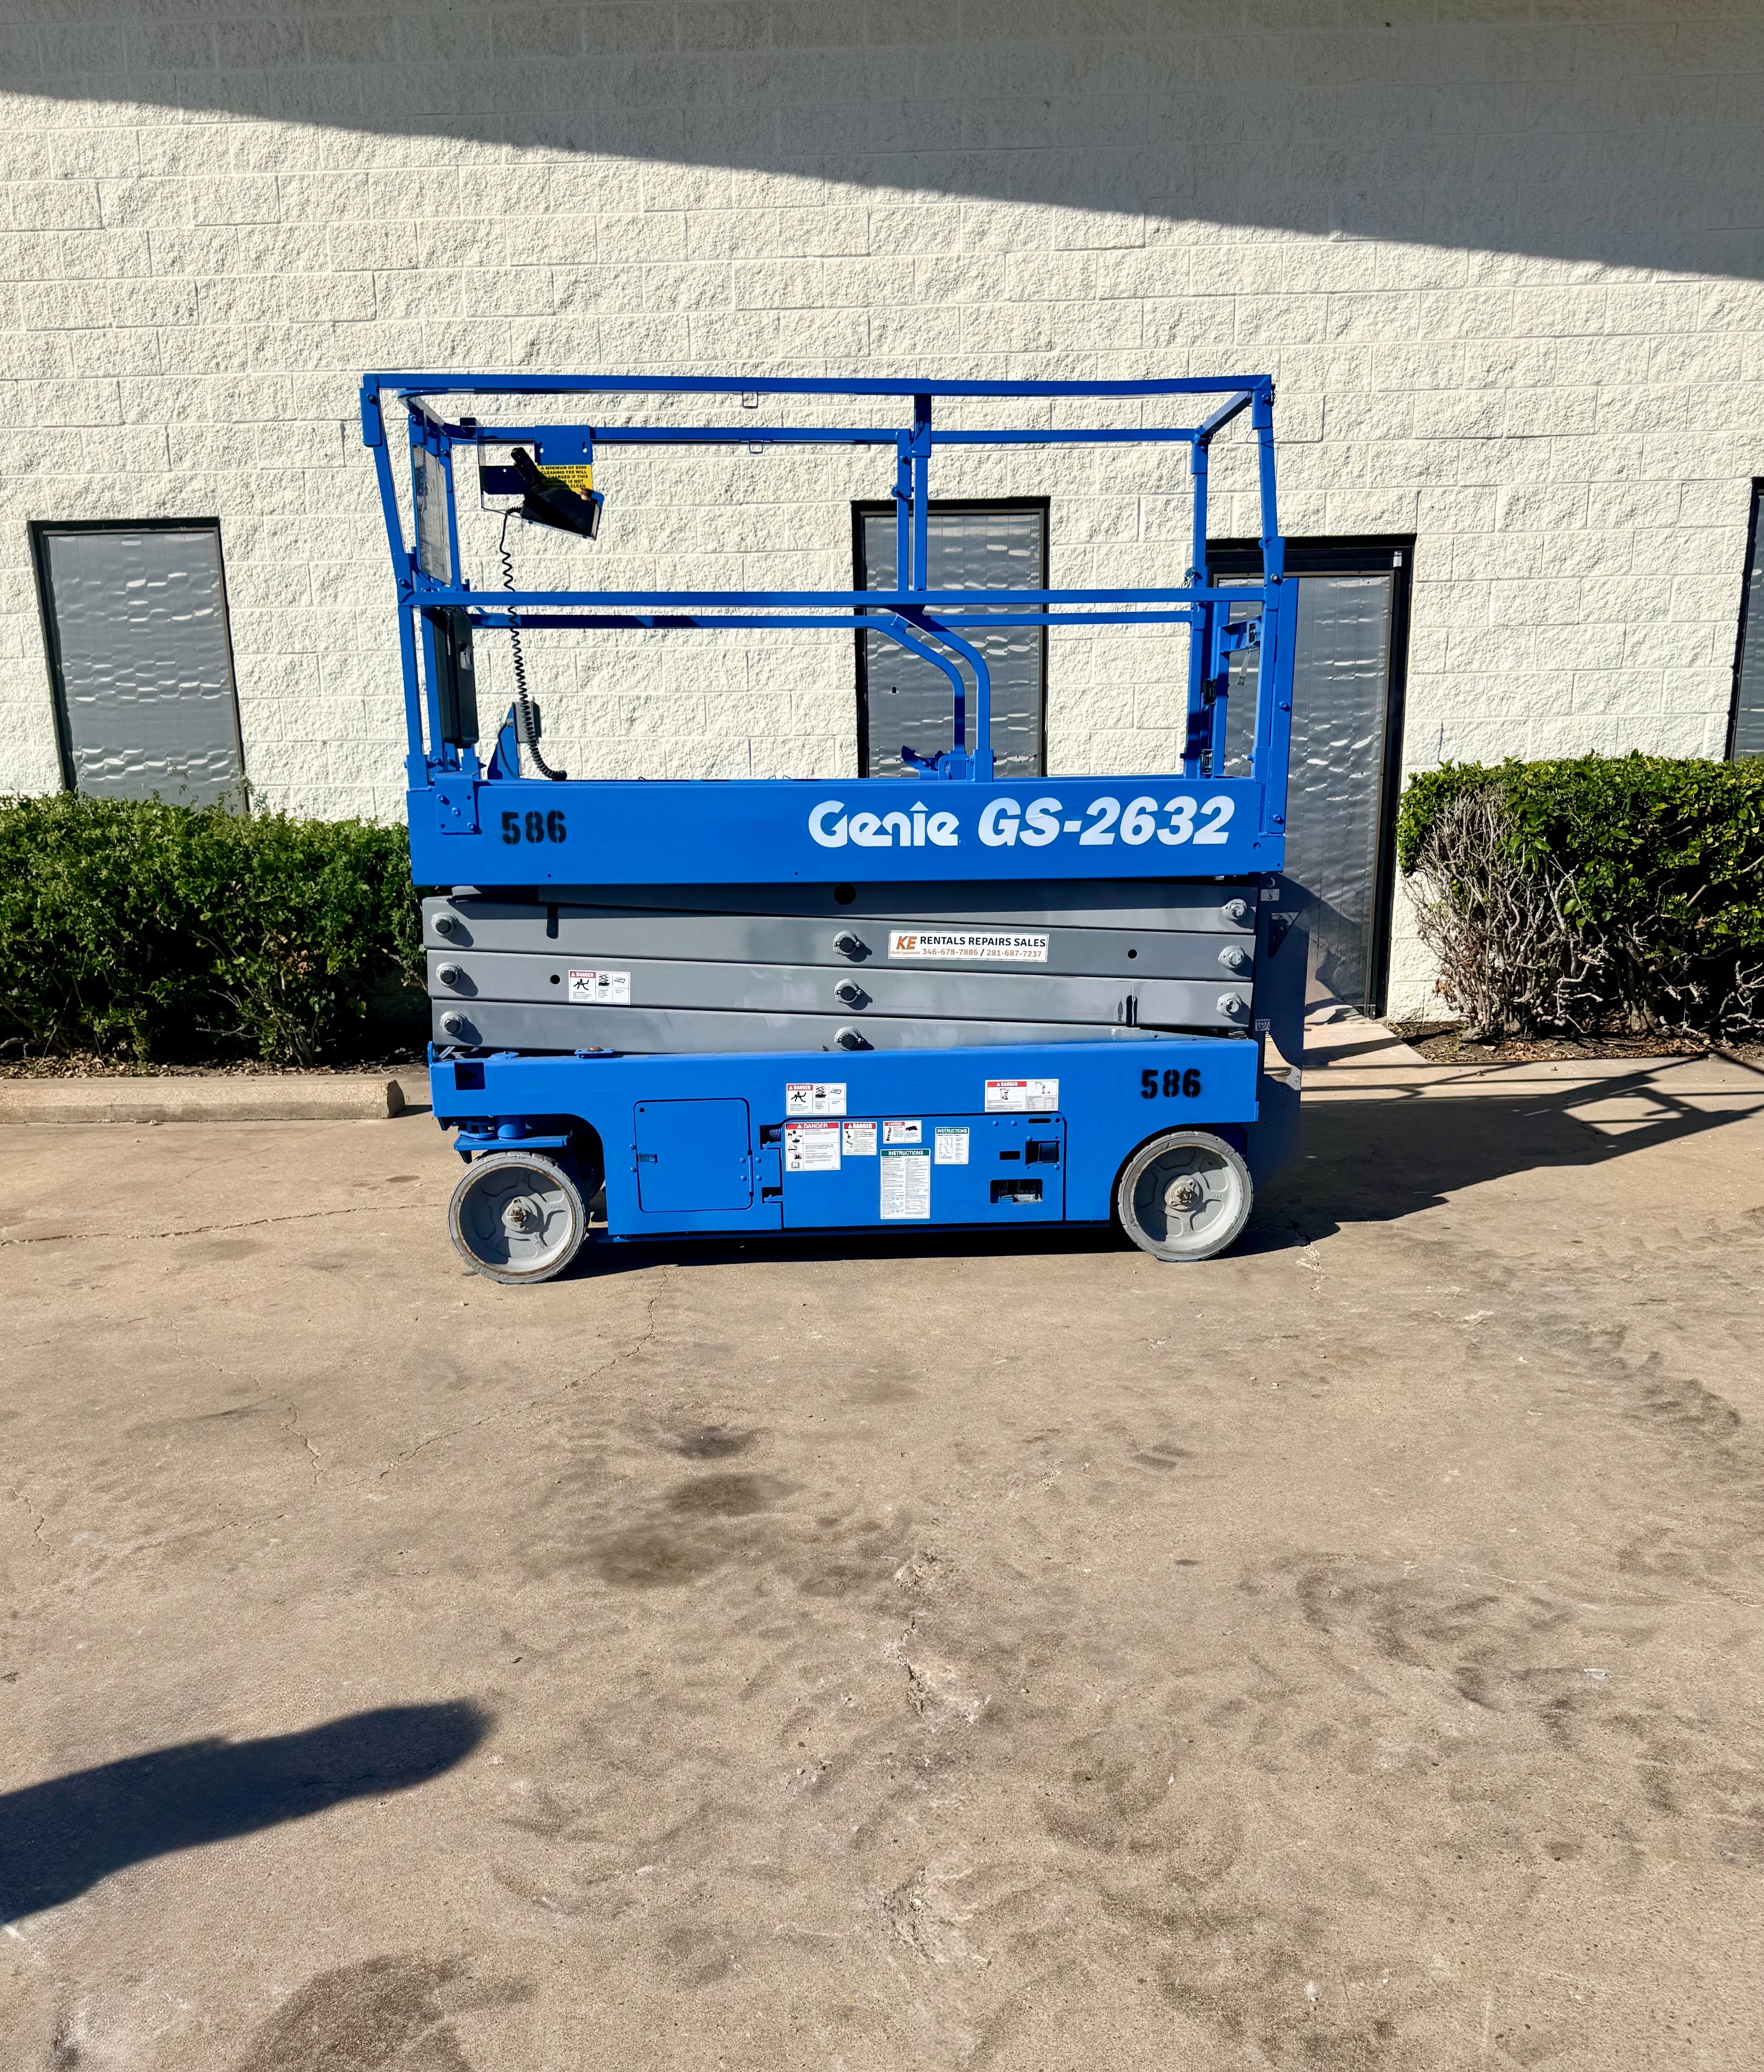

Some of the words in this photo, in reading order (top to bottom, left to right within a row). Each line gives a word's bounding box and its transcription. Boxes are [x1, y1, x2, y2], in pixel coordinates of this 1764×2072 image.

[502, 810, 567, 844] 586
[808, 800, 959, 849] Genie
[977, 795, 1236, 847] GS-2632
[896, 936, 918, 950] KE
[920, 936, 966, 945] RENTALS
[969, 937, 1011, 946] REPAIRS
[1014, 938, 1045, 947] SALES
[987, 949, 1042, 957] 281-687-7237
[1140, 1068, 1201, 1099] 586
